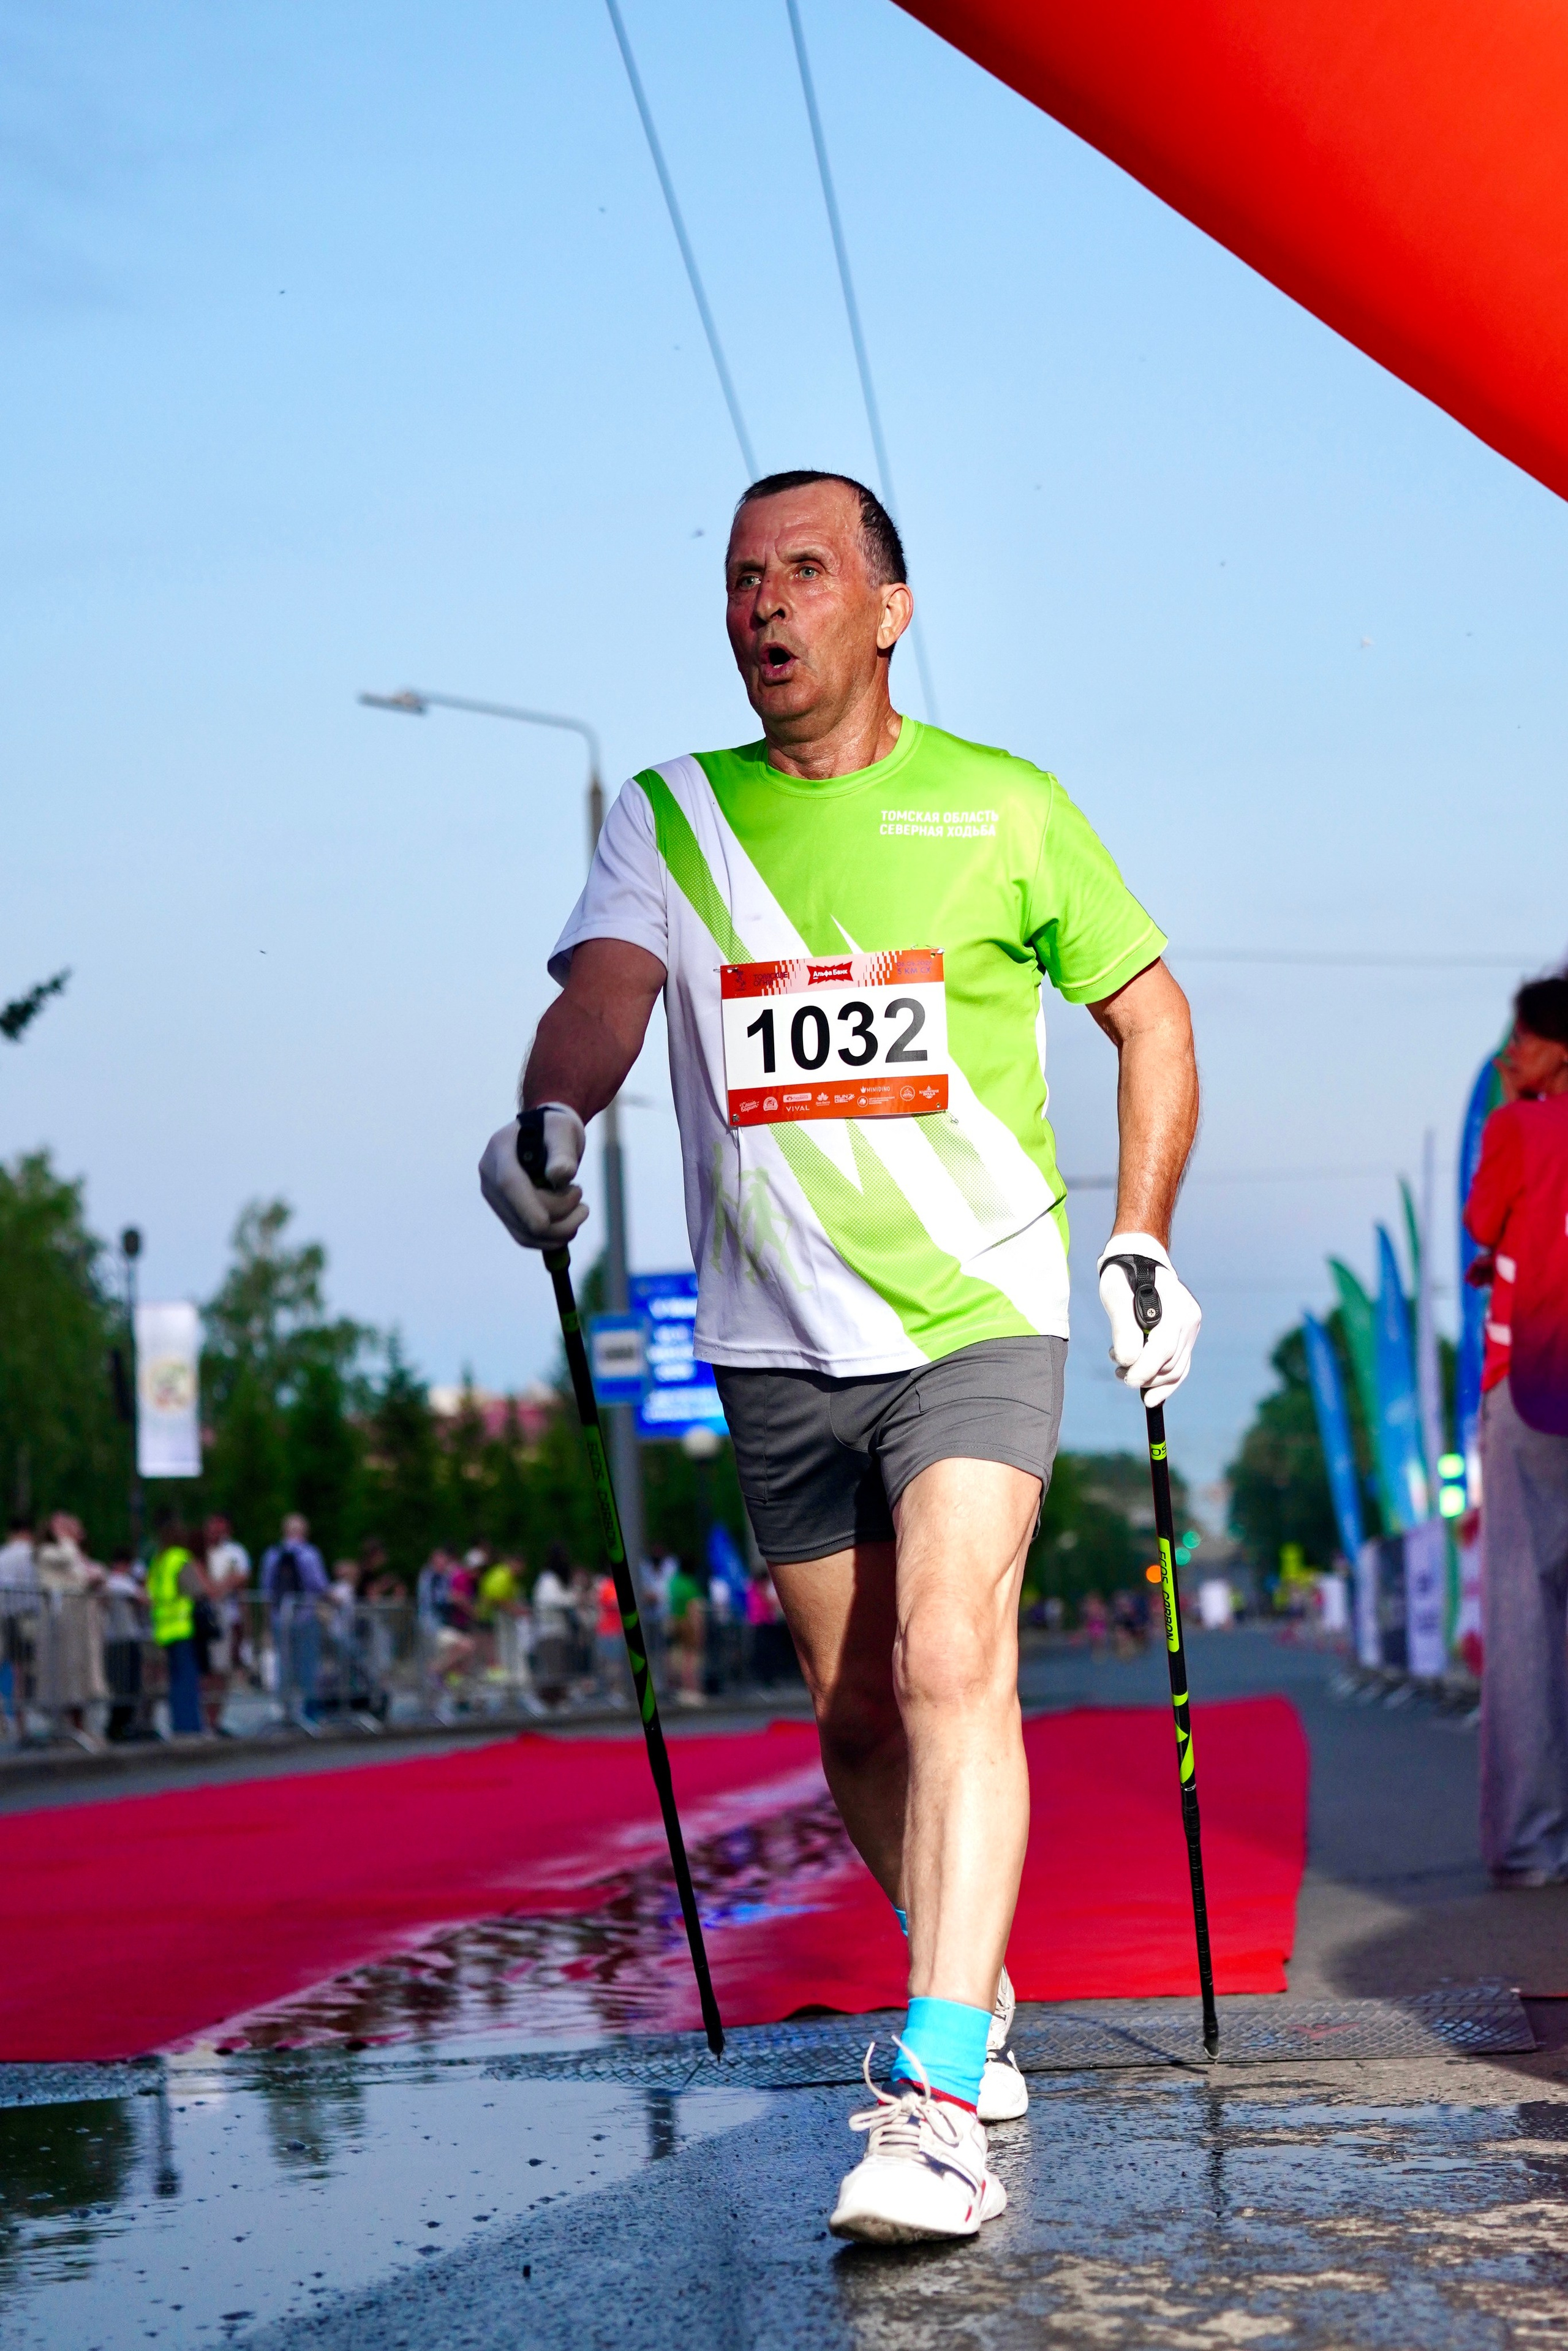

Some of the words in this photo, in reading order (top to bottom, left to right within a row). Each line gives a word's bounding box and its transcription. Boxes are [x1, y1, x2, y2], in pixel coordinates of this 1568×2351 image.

[881, 810, 940, 823] ТОМСКАЯ
[943, 809, 1000, 823] ОБЛАСТЬ
[880, 824, 943, 837] СЕВЕРНАЯ
[947, 825, 997, 838] ХОДЬБА
[813, 970, 832, 979] Альфа
[747, 997, 928, 1074] 1032
[1163, 1590, 1174, 1641] CARBON
